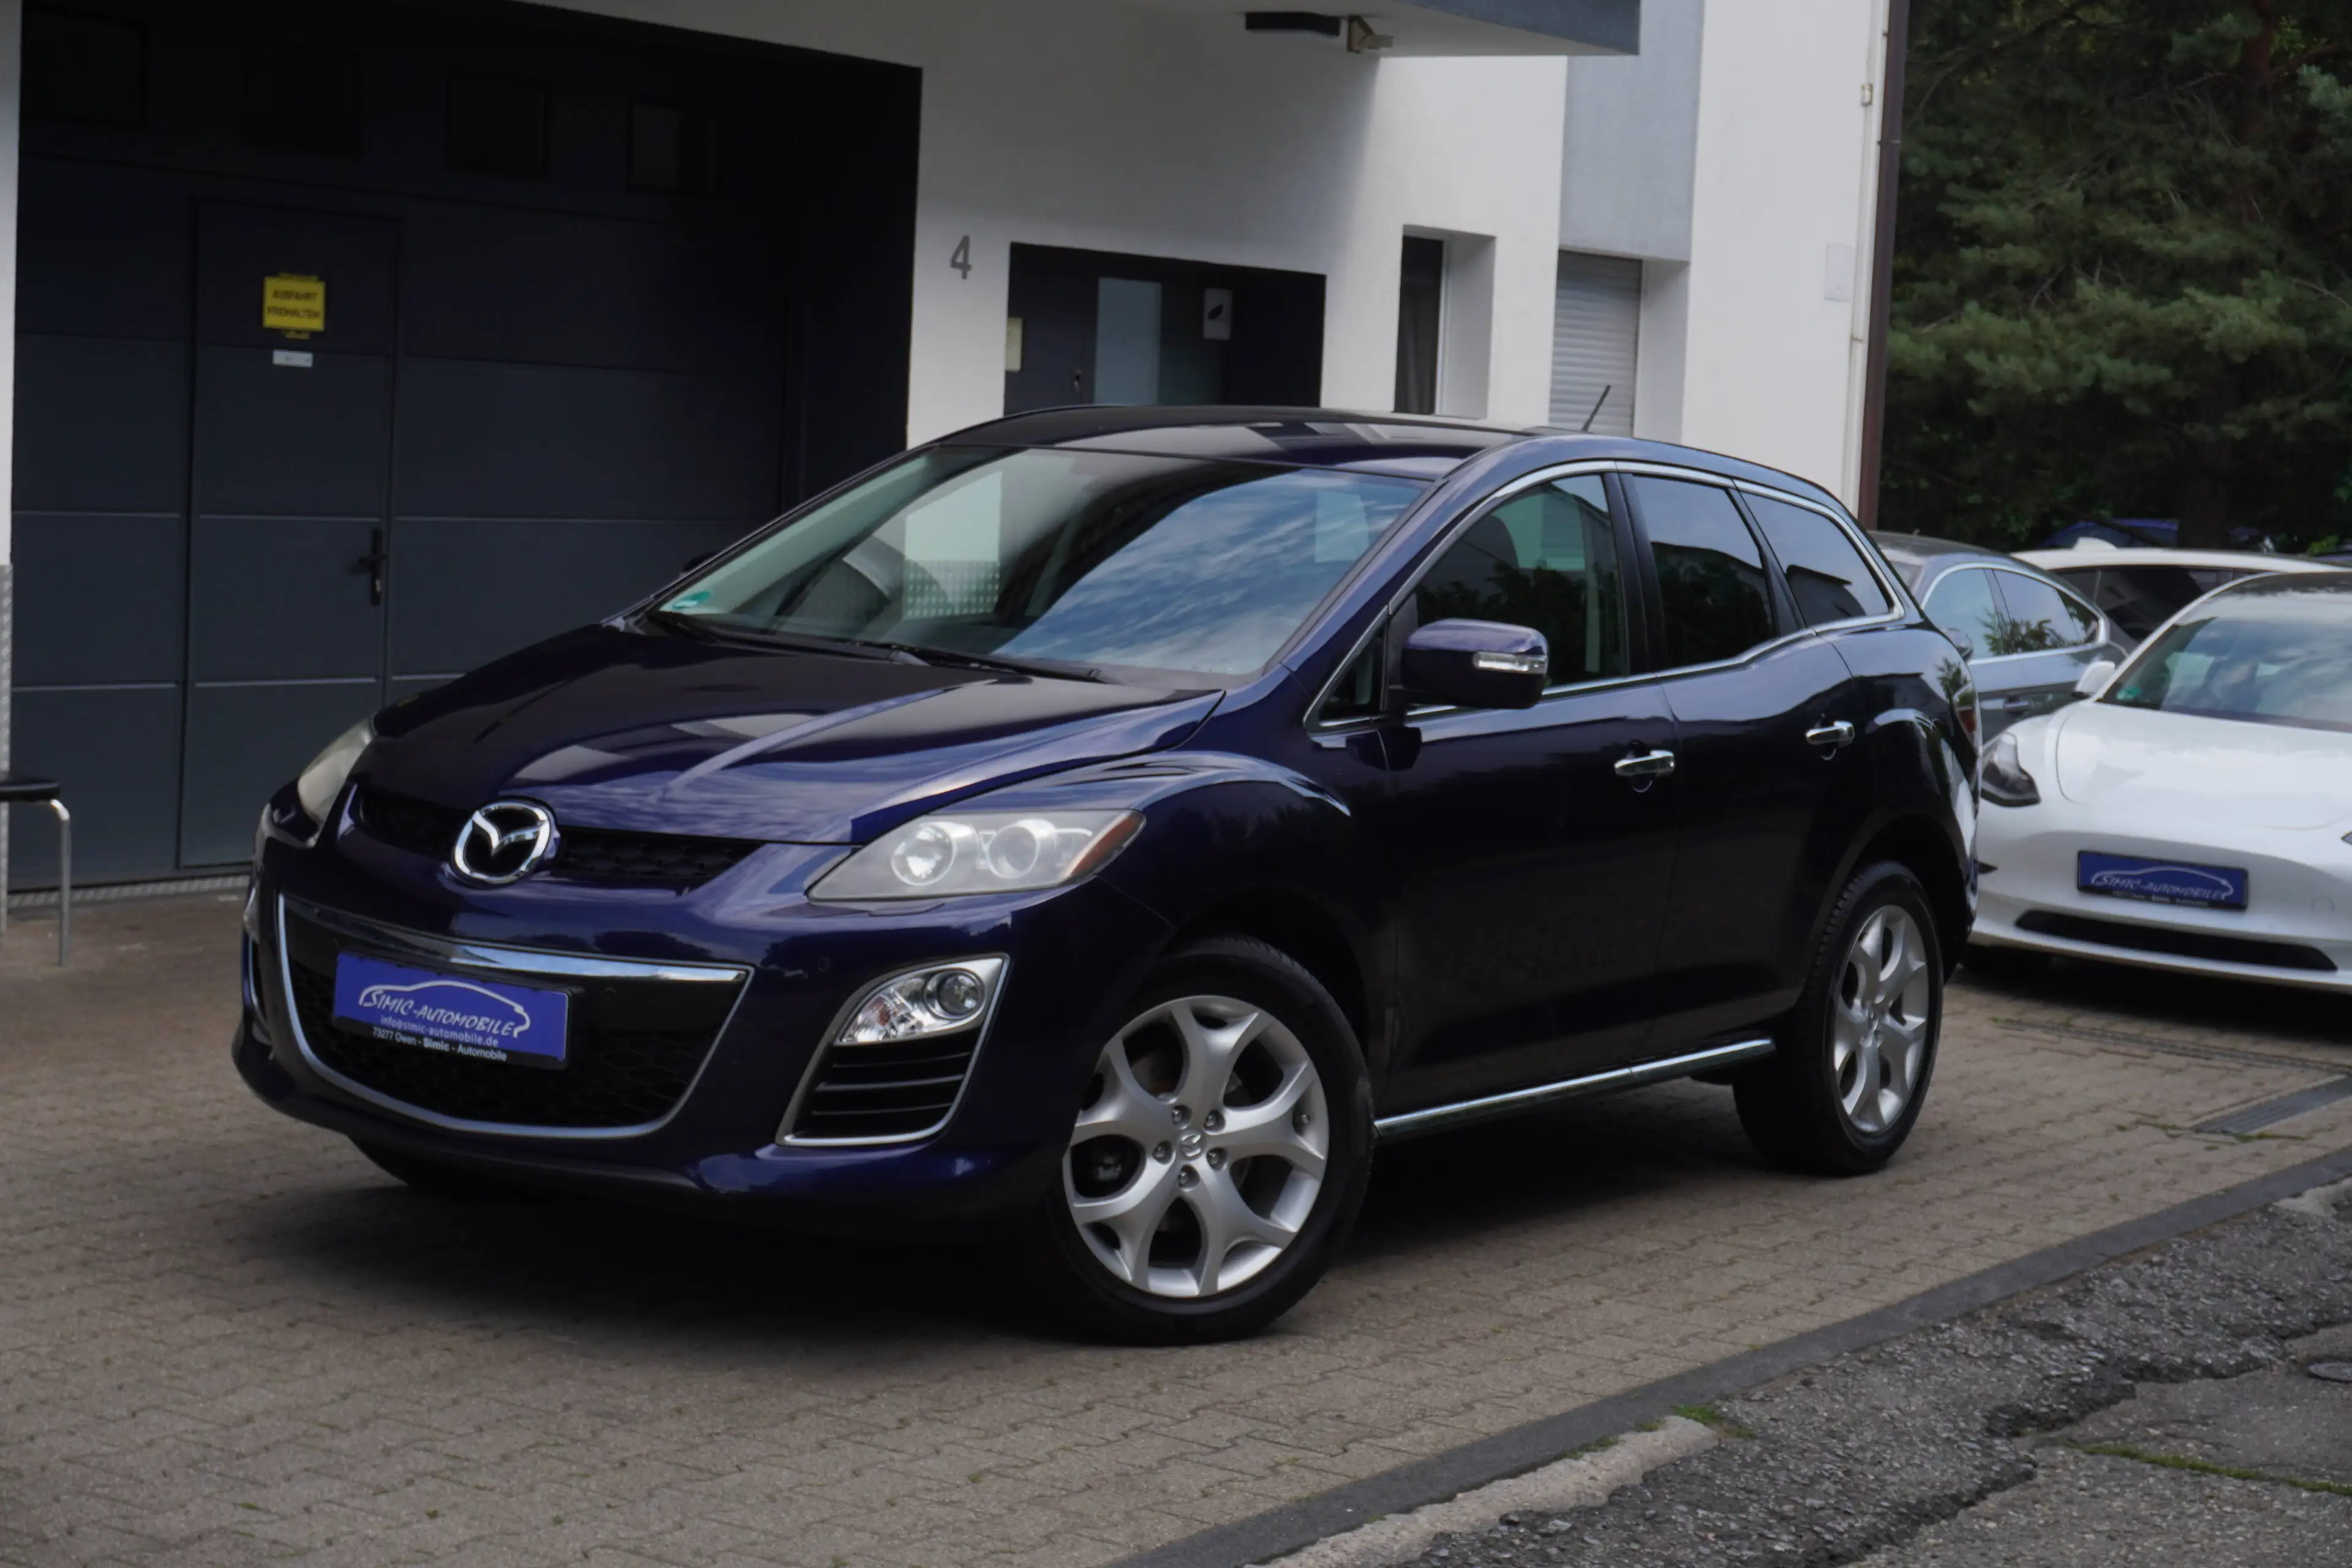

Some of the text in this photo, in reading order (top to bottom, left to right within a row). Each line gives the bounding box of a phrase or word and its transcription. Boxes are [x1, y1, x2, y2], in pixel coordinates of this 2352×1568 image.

[950, 235, 972, 280] 4
[380, 1015, 499, 1047] info@simic-automobile.de
[395, 1032, 417, 1046] Owen
[423, 1038, 449, 1052] Simic
[457, 1044, 507, 1062] Automobile
